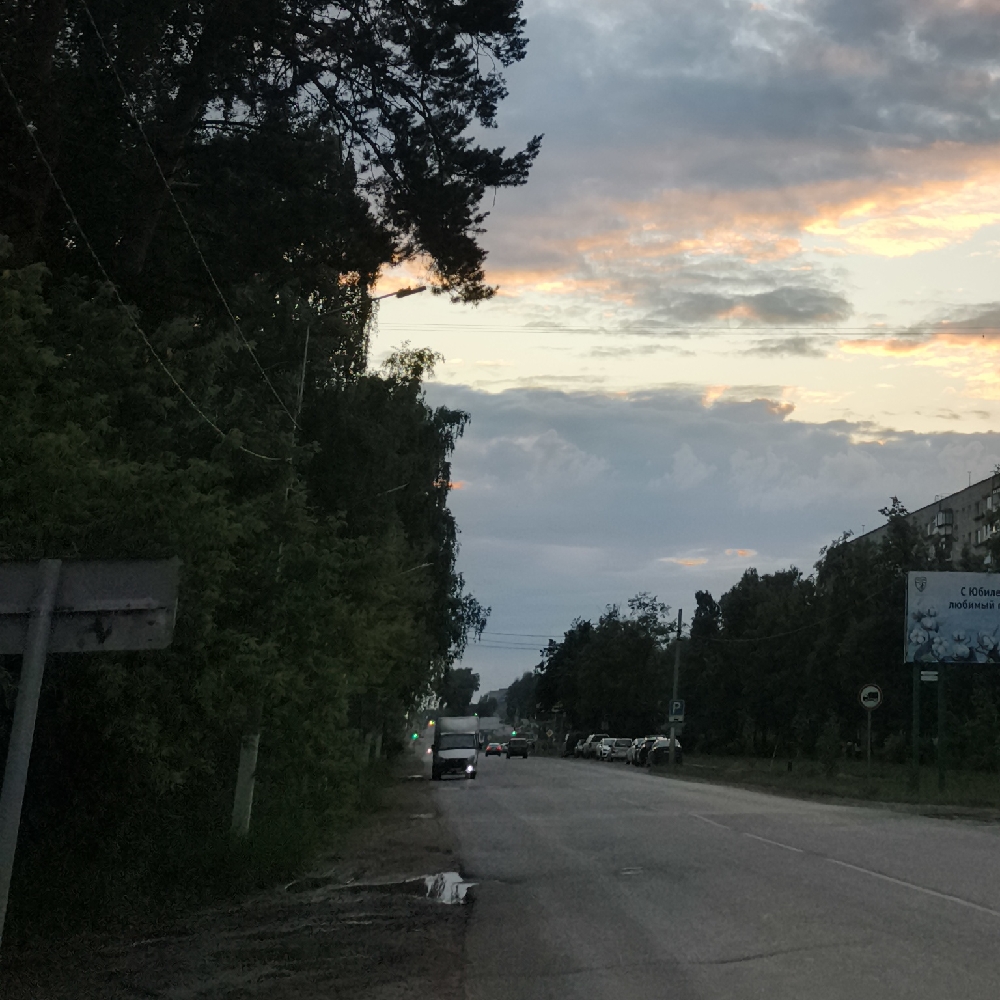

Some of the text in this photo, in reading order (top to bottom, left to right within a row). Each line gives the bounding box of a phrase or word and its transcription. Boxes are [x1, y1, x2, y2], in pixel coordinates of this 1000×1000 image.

[961, 587, 966, 596] С
[948, 599, 994, 609] любимый
[672, 701, 681, 714] P
